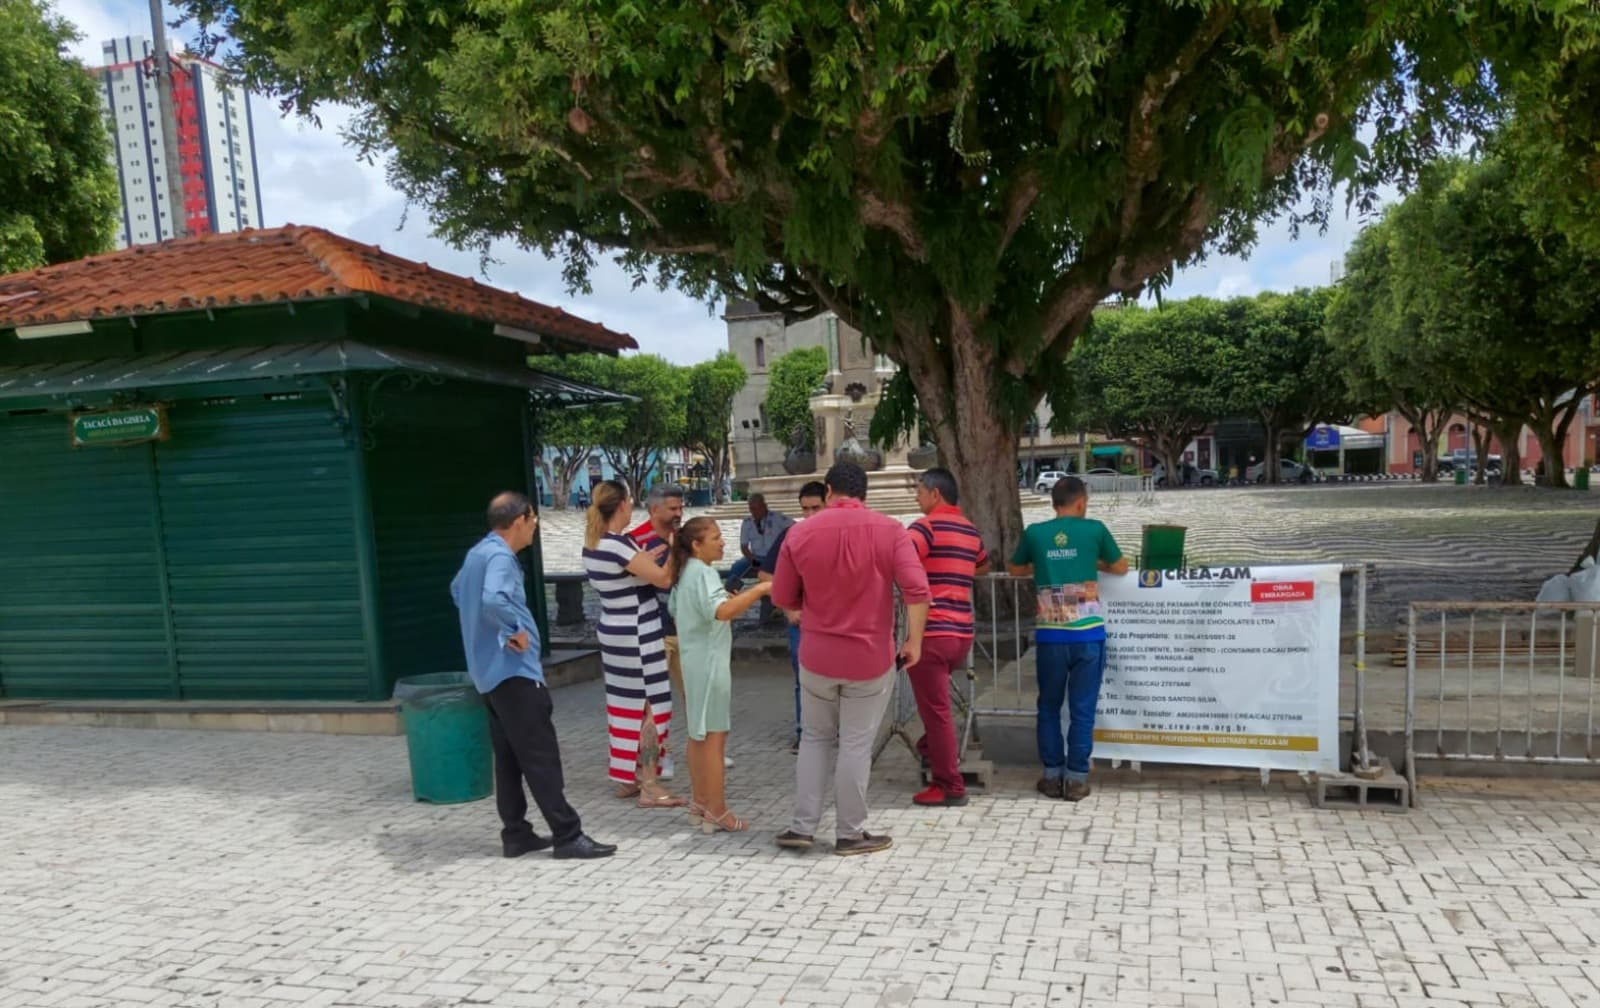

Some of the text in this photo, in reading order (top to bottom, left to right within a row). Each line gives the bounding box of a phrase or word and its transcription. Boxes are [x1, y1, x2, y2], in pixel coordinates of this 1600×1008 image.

[83, 415, 151, 429] TACACÁ DA GISELA
[1047, 549, 1078, 558] AMAZONAS
[1108, 600, 1155, 608] CONSTRUÇÃO
[1127, 608, 1170, 616] INSTALAÇÃO
